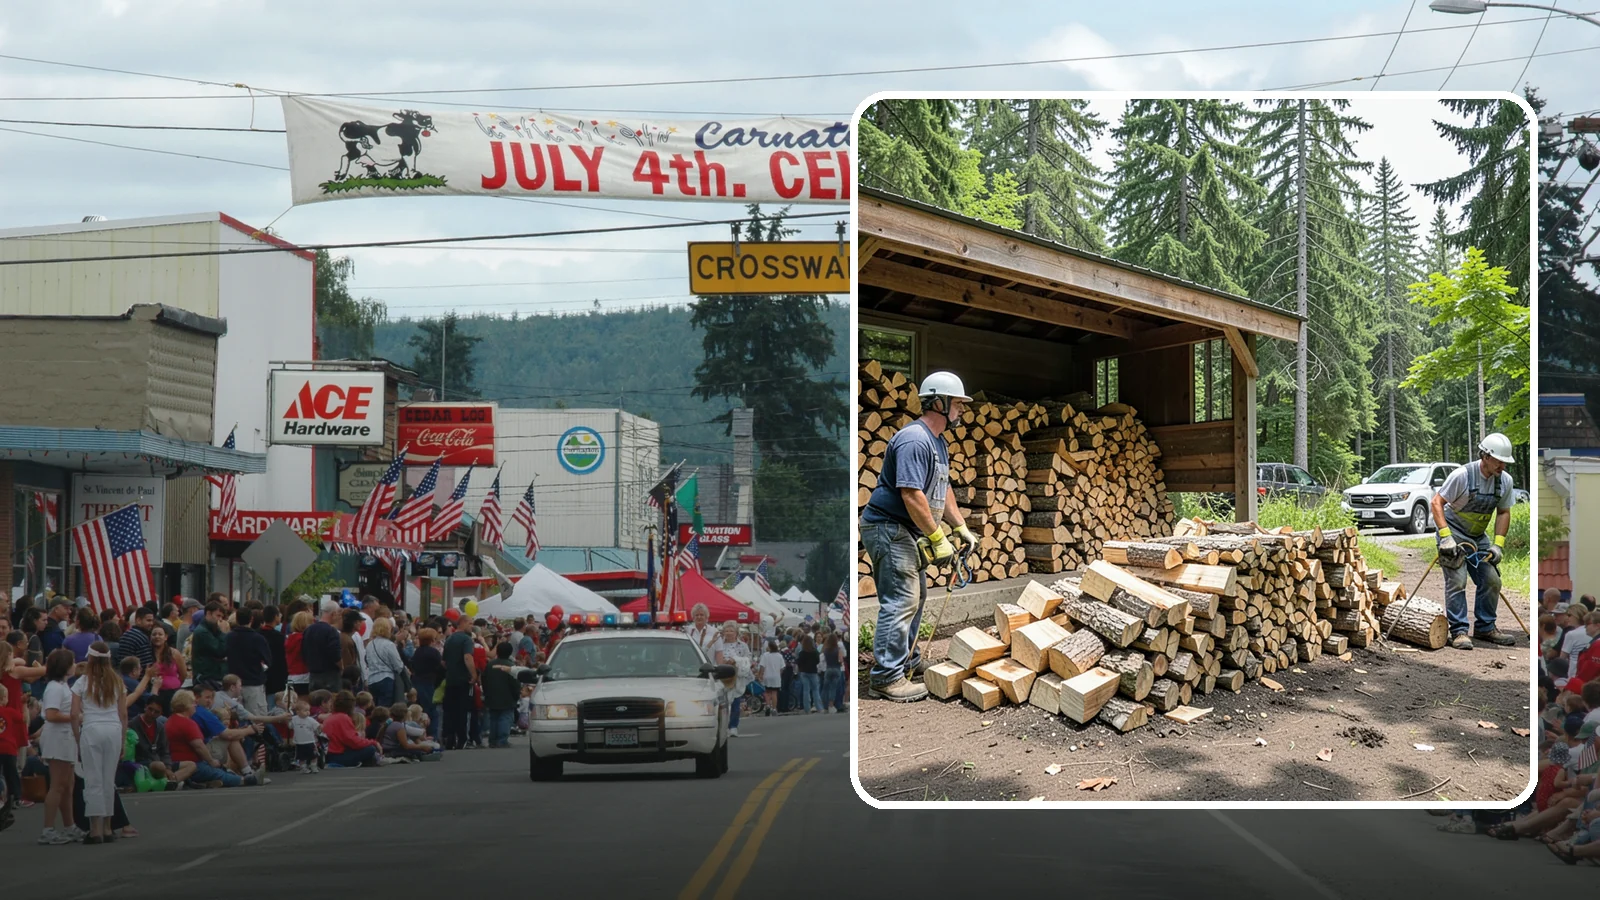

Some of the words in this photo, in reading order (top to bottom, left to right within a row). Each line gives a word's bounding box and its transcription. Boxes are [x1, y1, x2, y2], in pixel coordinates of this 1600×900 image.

[695, 121, 850, 150] Carnat
[481, 141, 605, 192] JULY
[632, 150, 746, 198] 4th.
[697, 254, 850, 280] CROSSWA
[283, 380, 373, 420] ACE
[405, 409, 452, 422] CEDAR
[283, 421, 371, 437] Hardware
[416, 428, 477, 447] Coca-Cola
[83, 485, 92, 494] St.
[95, 485, 124, 494] Vincent
[126, 486, 135, 495] de
[137, 486, 155, 495] Paul
[688, 526, 741, 535] CRNATION
[699, 535, 730, 543] GLASS
